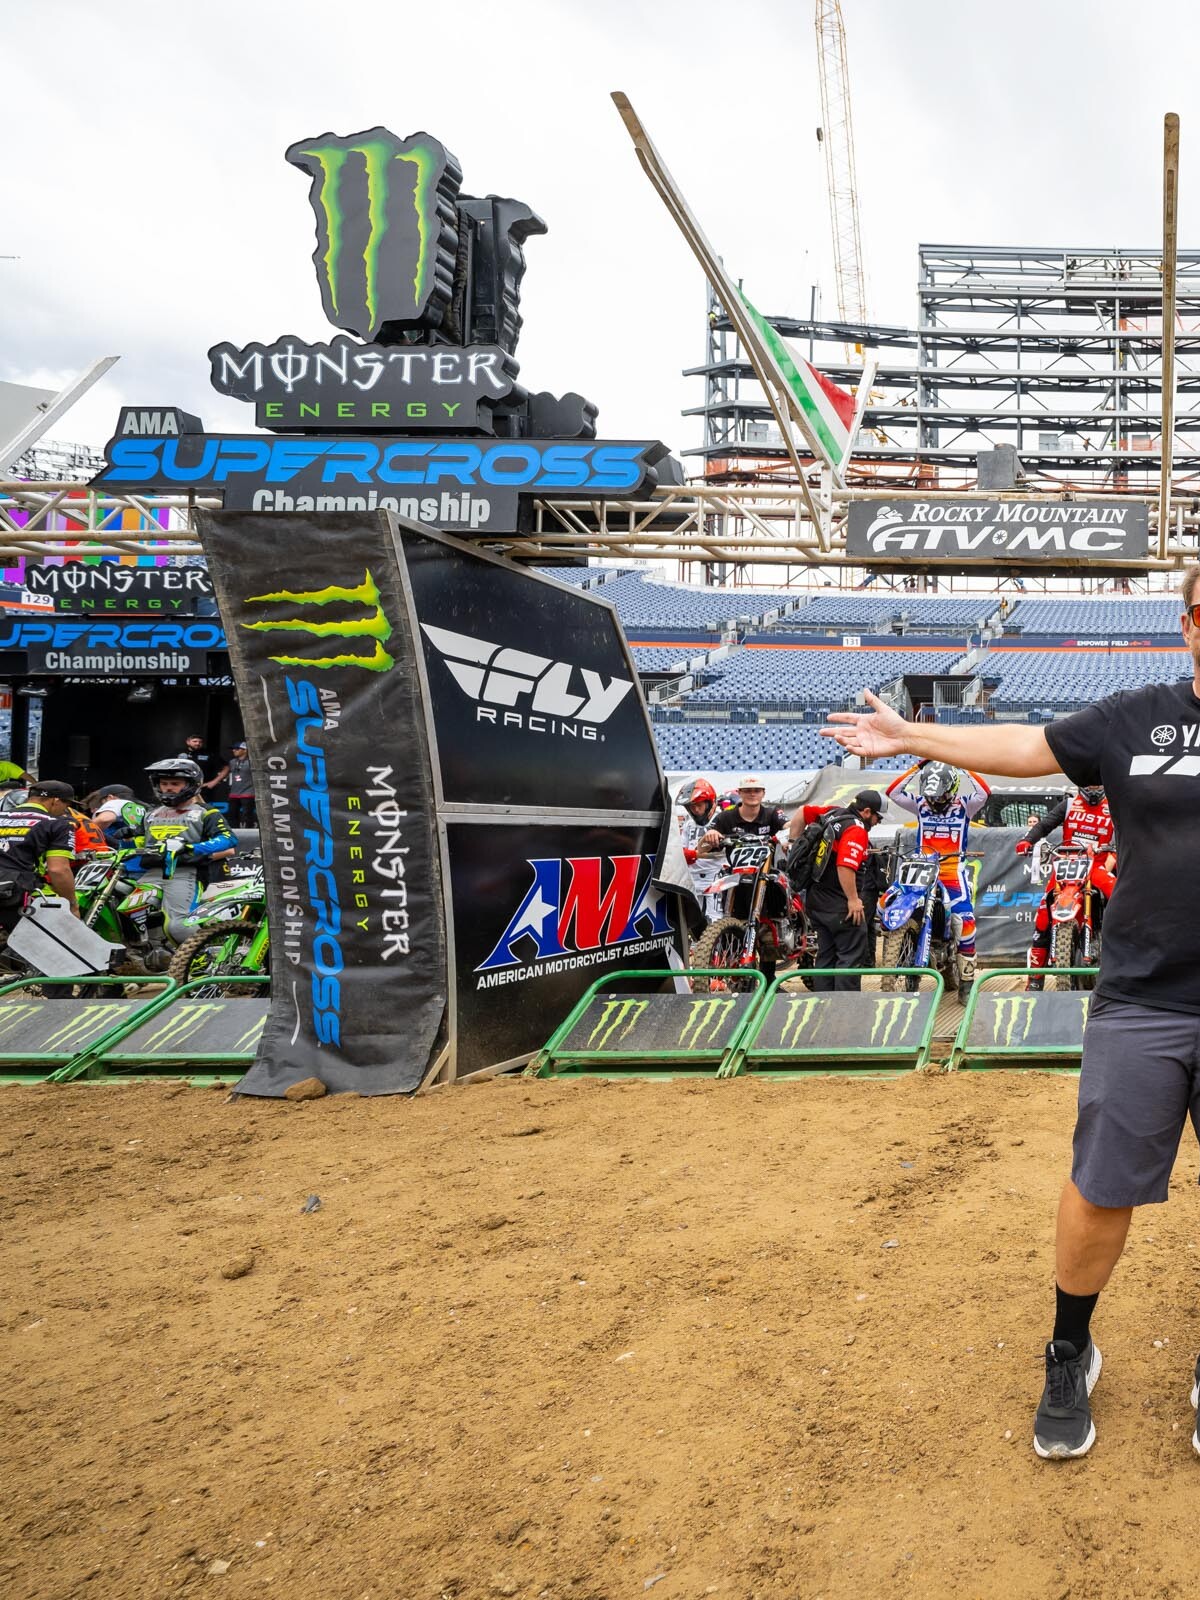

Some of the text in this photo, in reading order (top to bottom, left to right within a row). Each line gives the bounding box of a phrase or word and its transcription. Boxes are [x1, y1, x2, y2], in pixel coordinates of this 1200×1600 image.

[221, 344, 506, 392] MONSTER
[265, 401, 462, 418] ENERGY
[121, 411, 180, 435] AMA
[102, 438, 647, 487] SUPERCROSS
[908, 503, 1128, 524] ROCKY MOUNTAIN
[31, 566, 213, 593] MONSTER
[25, 594, 51, 605] 129
[60, 599, 184, 609] ENERGY
[844, 637, 859, 646] 131
[45, 651, 191, 672] Championship
[420, 622, 635, 723] FLY
[318, 687, 342, 731] AMA
[476, 706, 600, 741] RACING
[1068, 811, 1112, 827] JUST1
[266, 755, 304, 966] CHAMPIONSHIP
[285, 675, 343, 1049] SUPERCROSS
[346, 796, 371, 932] ENERGY
[365, 764, 411, 962] MONSTER
[731, 847, 769, 868] 129
[900, 863, 938, 885] 173
[1056, 860, 1088, 881] 597
[986, 884, 1007, 893] AMA
[473, 854, 675, 972] AMA
[476, 936, 675, 990] AMERICAN MOTORCYCLIST ASSOCIATION
